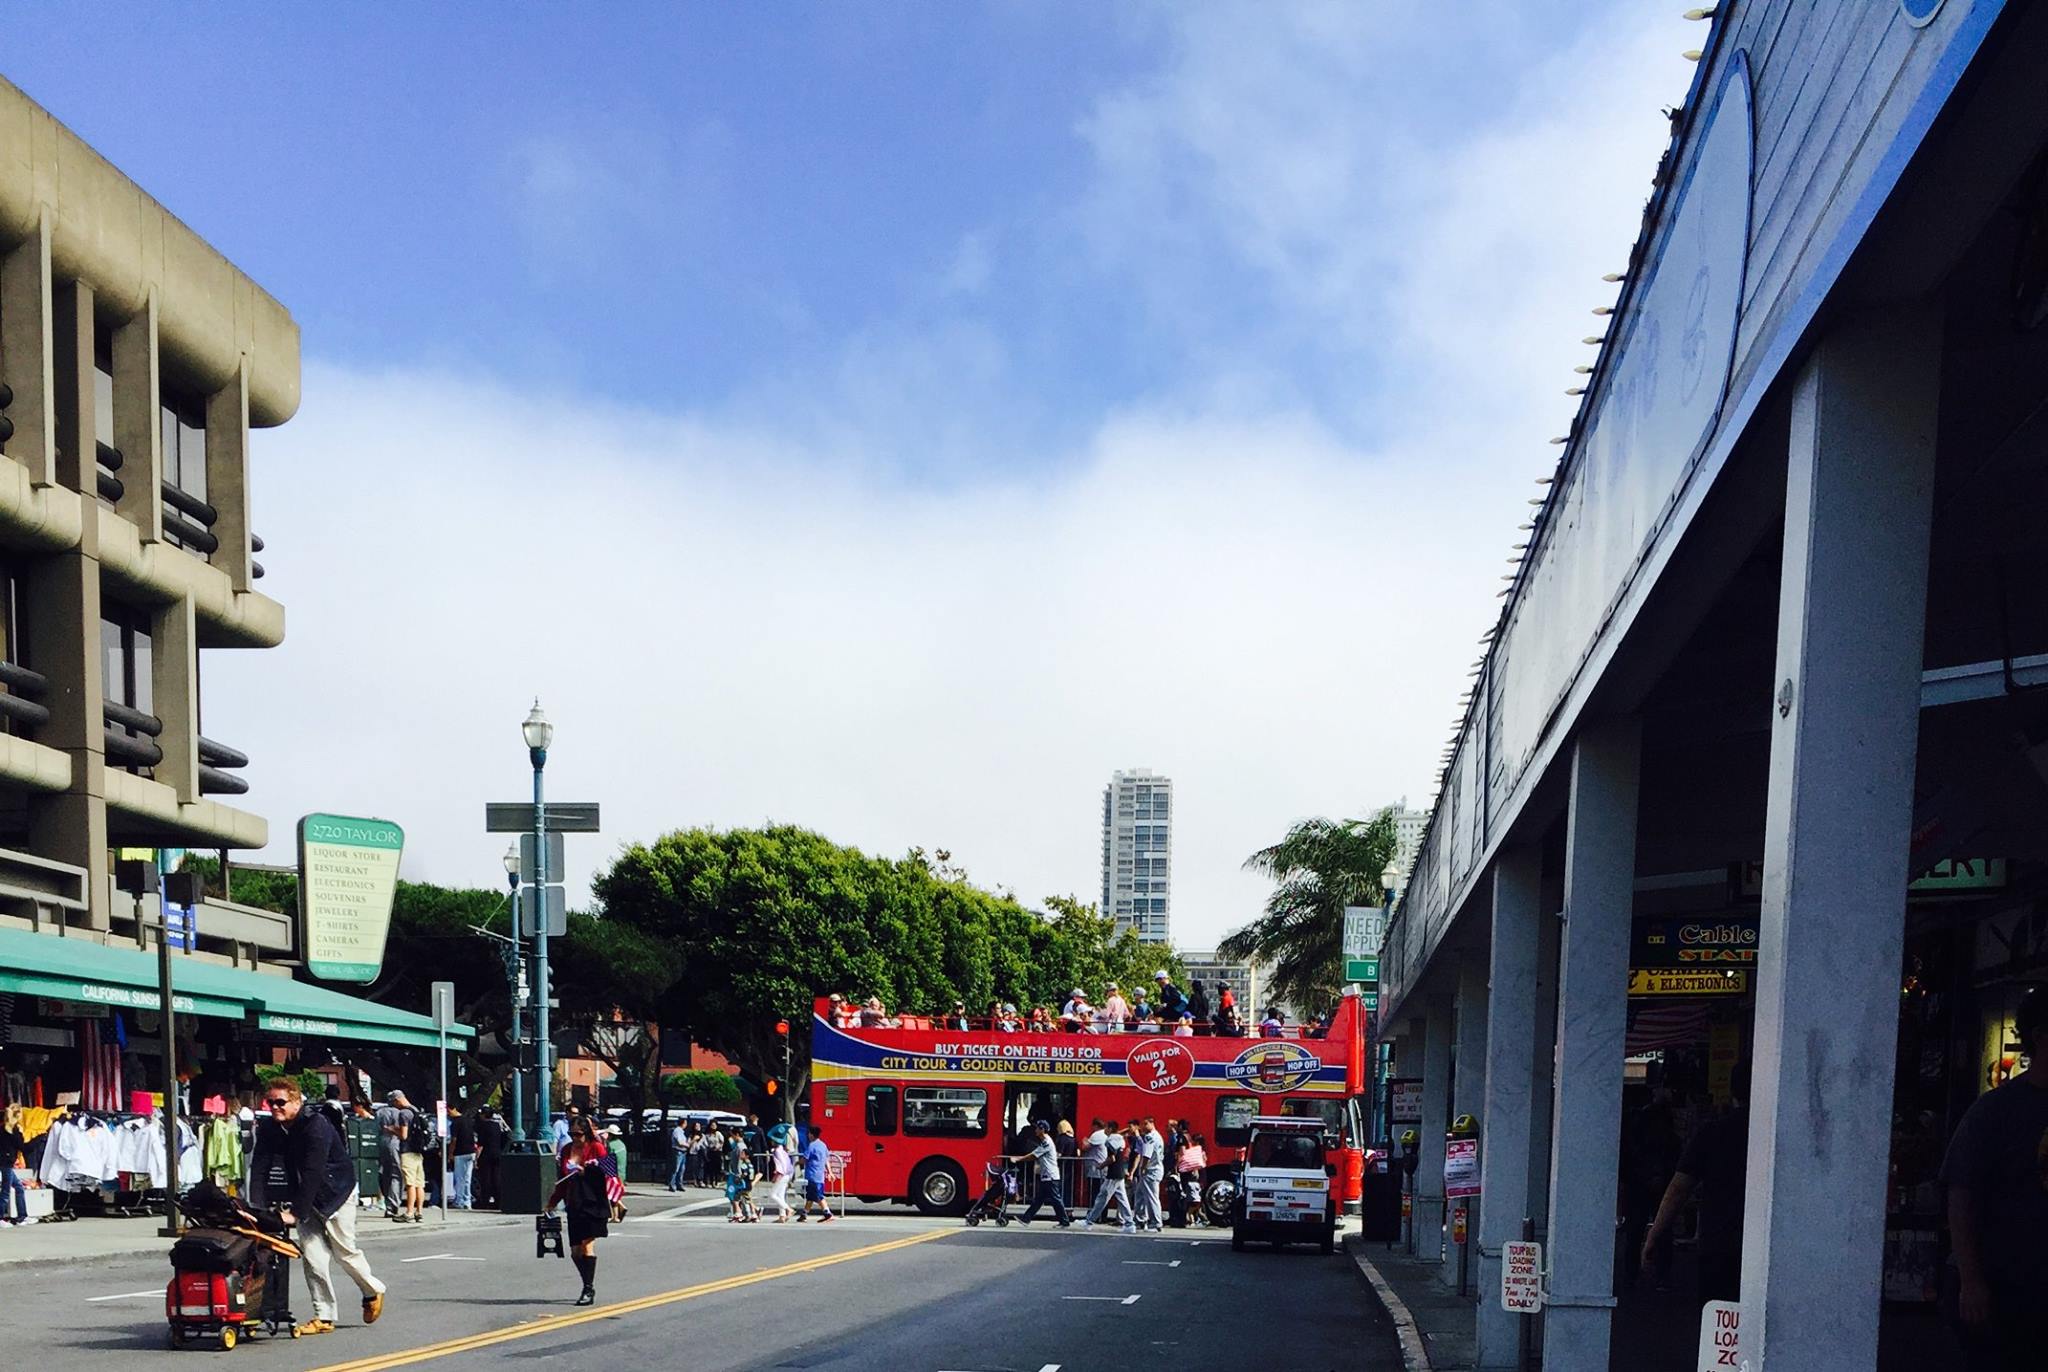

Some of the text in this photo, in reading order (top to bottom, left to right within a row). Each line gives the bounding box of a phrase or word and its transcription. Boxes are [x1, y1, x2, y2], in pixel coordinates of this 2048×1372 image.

[313, 824, 398, 844] 2720 TAYLOR
[313, 848, 381, 862] LIQUOR STORE
[314, 864, 369, 875] RESTAURANT
[314, 877, 375, 890] ELECTRONICS
[315, 892, 367, 904] SOUVENIRS
[1345, 917, 1382, 935] NEED
[316, 934, 359, 945] CAMERAS
[1679, 924, 1756, 944] Cable
[1344, 936, 1381, 951] APPLY
[316, 949, 342, 958] GIFTS
[1679, 948, 1759, 961] STAT
[1646, 979, 1656, 991] &
[1660, 977, 1740, 991] ELECTRONICS
[82, 984, 194, 1010] CALIFORNIA SUNSHI GIFTS
[269, 1016, 338, 1034] CABLE CAR SOUVENIRS
[935, 1043, 1102, 1059] BUY TICKET ON THE BUS FOR
[1133, 1046, 1181, 1064] VALID FOR
[881, 1057, 908, 1069] CITY
[912, 1058, 947, 1070] TOUR
[960, 1059, 1014, 1072] GOLDEN
[1018, 1061, 1051, 1072] GATE
[1152, 1060, 1167, 1077] 2
[1229, 1064, 1258, 1076] HOP ON
[1287, 1058, 1317, 1071] HOP OFF
[1150, 1074, 1178, 1090] DAYS
[1509, 1246, 1536, 1256] TOUR BUS
[1509, 1257, 1536, 1265] LOADING
[1511, 1266, 1533, 1274] ZONE
[1508, 1299, 1534, 1308] DAILY
[1716, 1310, 1739, 1329] TOU
